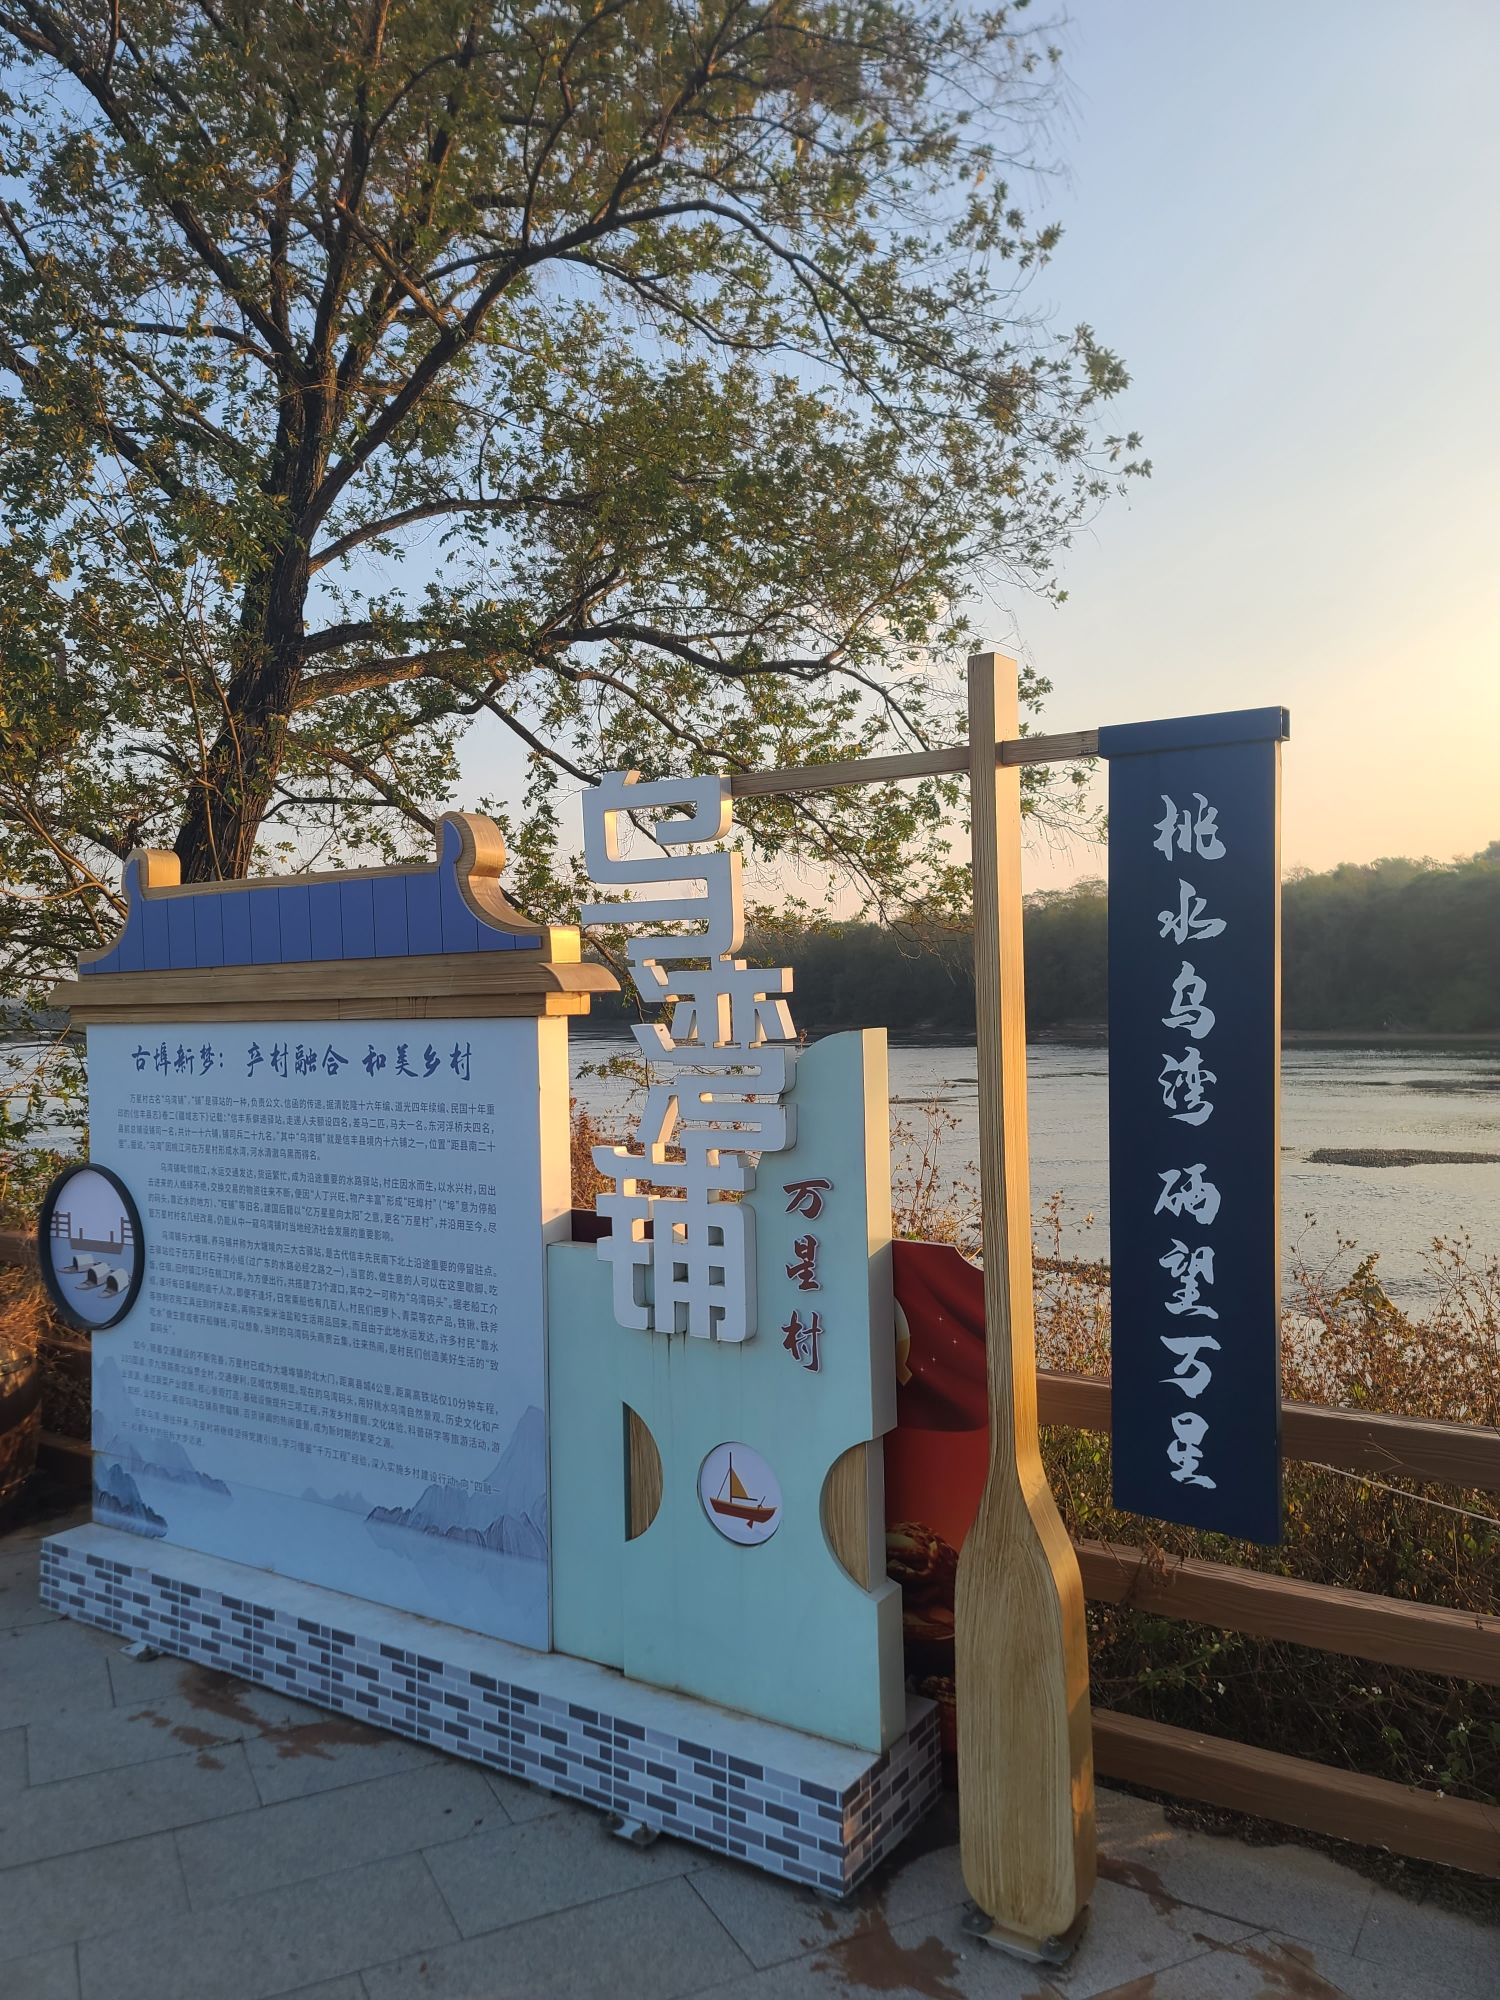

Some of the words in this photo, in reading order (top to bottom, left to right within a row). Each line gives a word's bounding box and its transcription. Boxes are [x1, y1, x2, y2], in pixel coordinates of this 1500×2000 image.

[361, 1041, 473, 1082] 和美乡村
[581, 769, 797, 1343] 乌湾铺
[1153, 792, 1228, 1127] 桃水乌湾
[782, 1178, 832, 1373] 万星村
